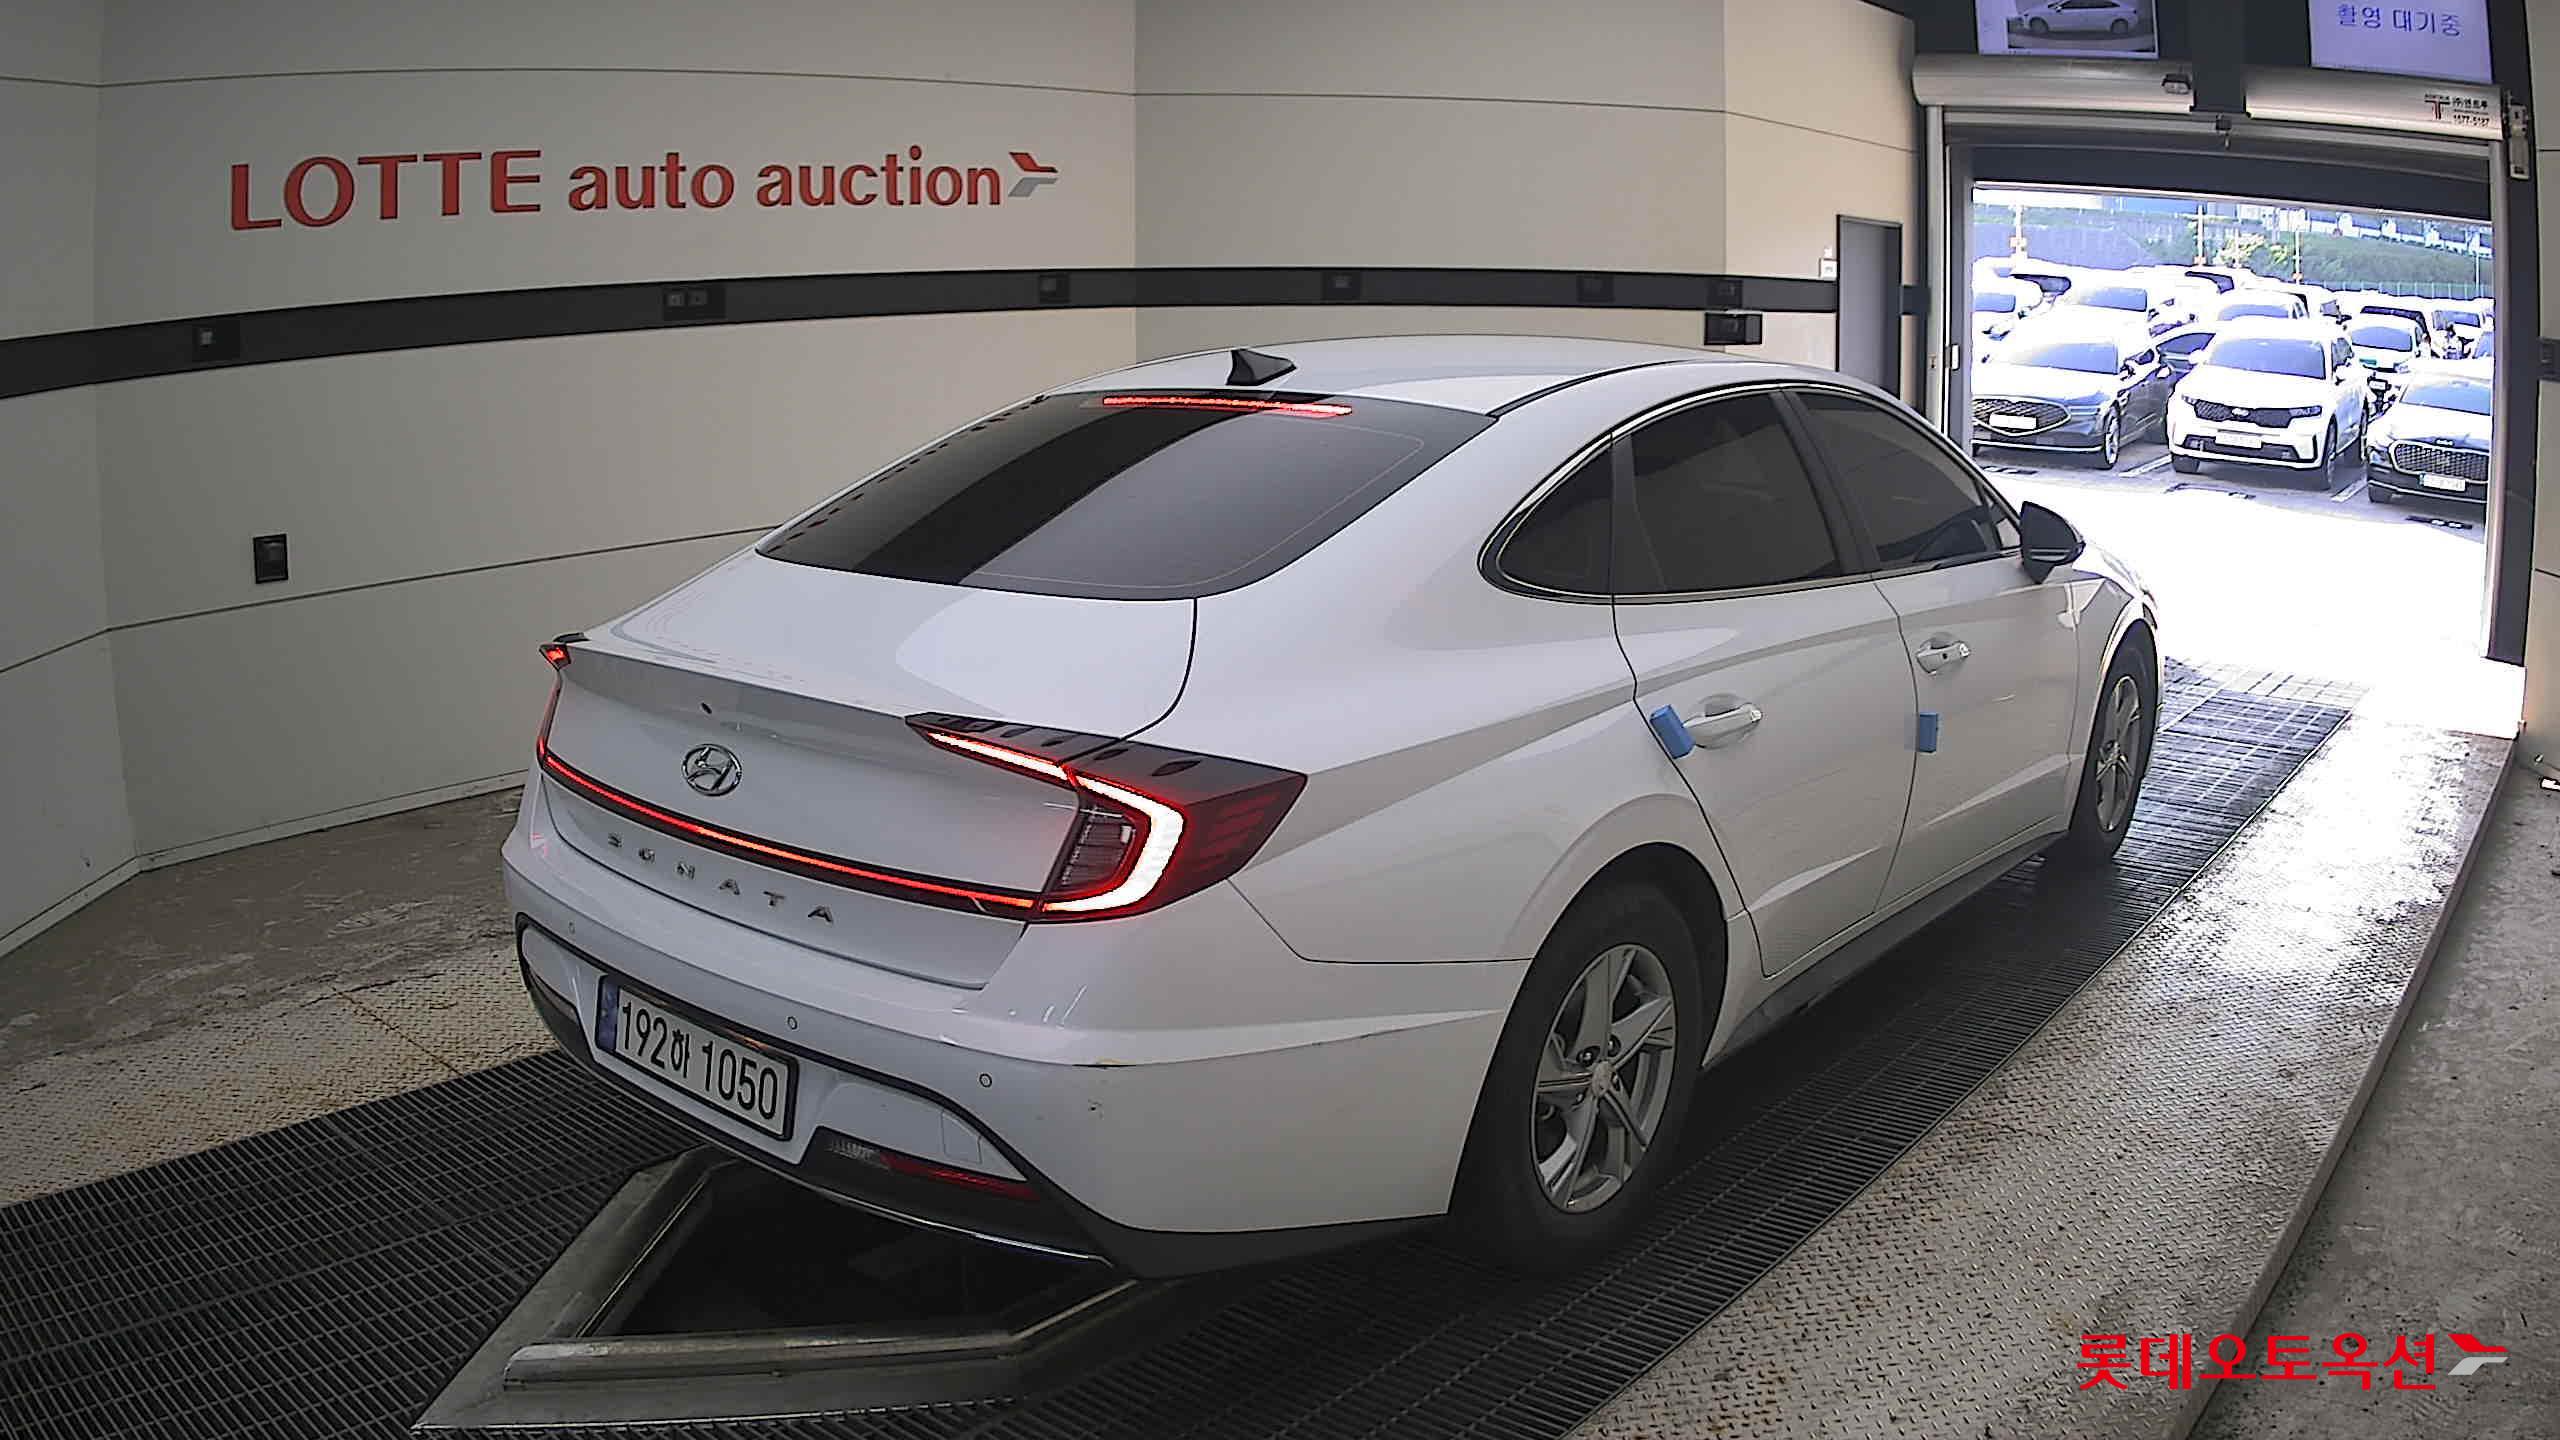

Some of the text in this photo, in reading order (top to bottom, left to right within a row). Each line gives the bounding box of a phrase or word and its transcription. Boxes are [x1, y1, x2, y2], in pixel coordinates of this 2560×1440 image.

[2392, 9, 2461, 37] 대기중
[231, 145, 1001, 231] LOTTE auto auction
[607, 831, 834, 924] SONATA
[622, 1000, 778, 1121] 192하 1050
